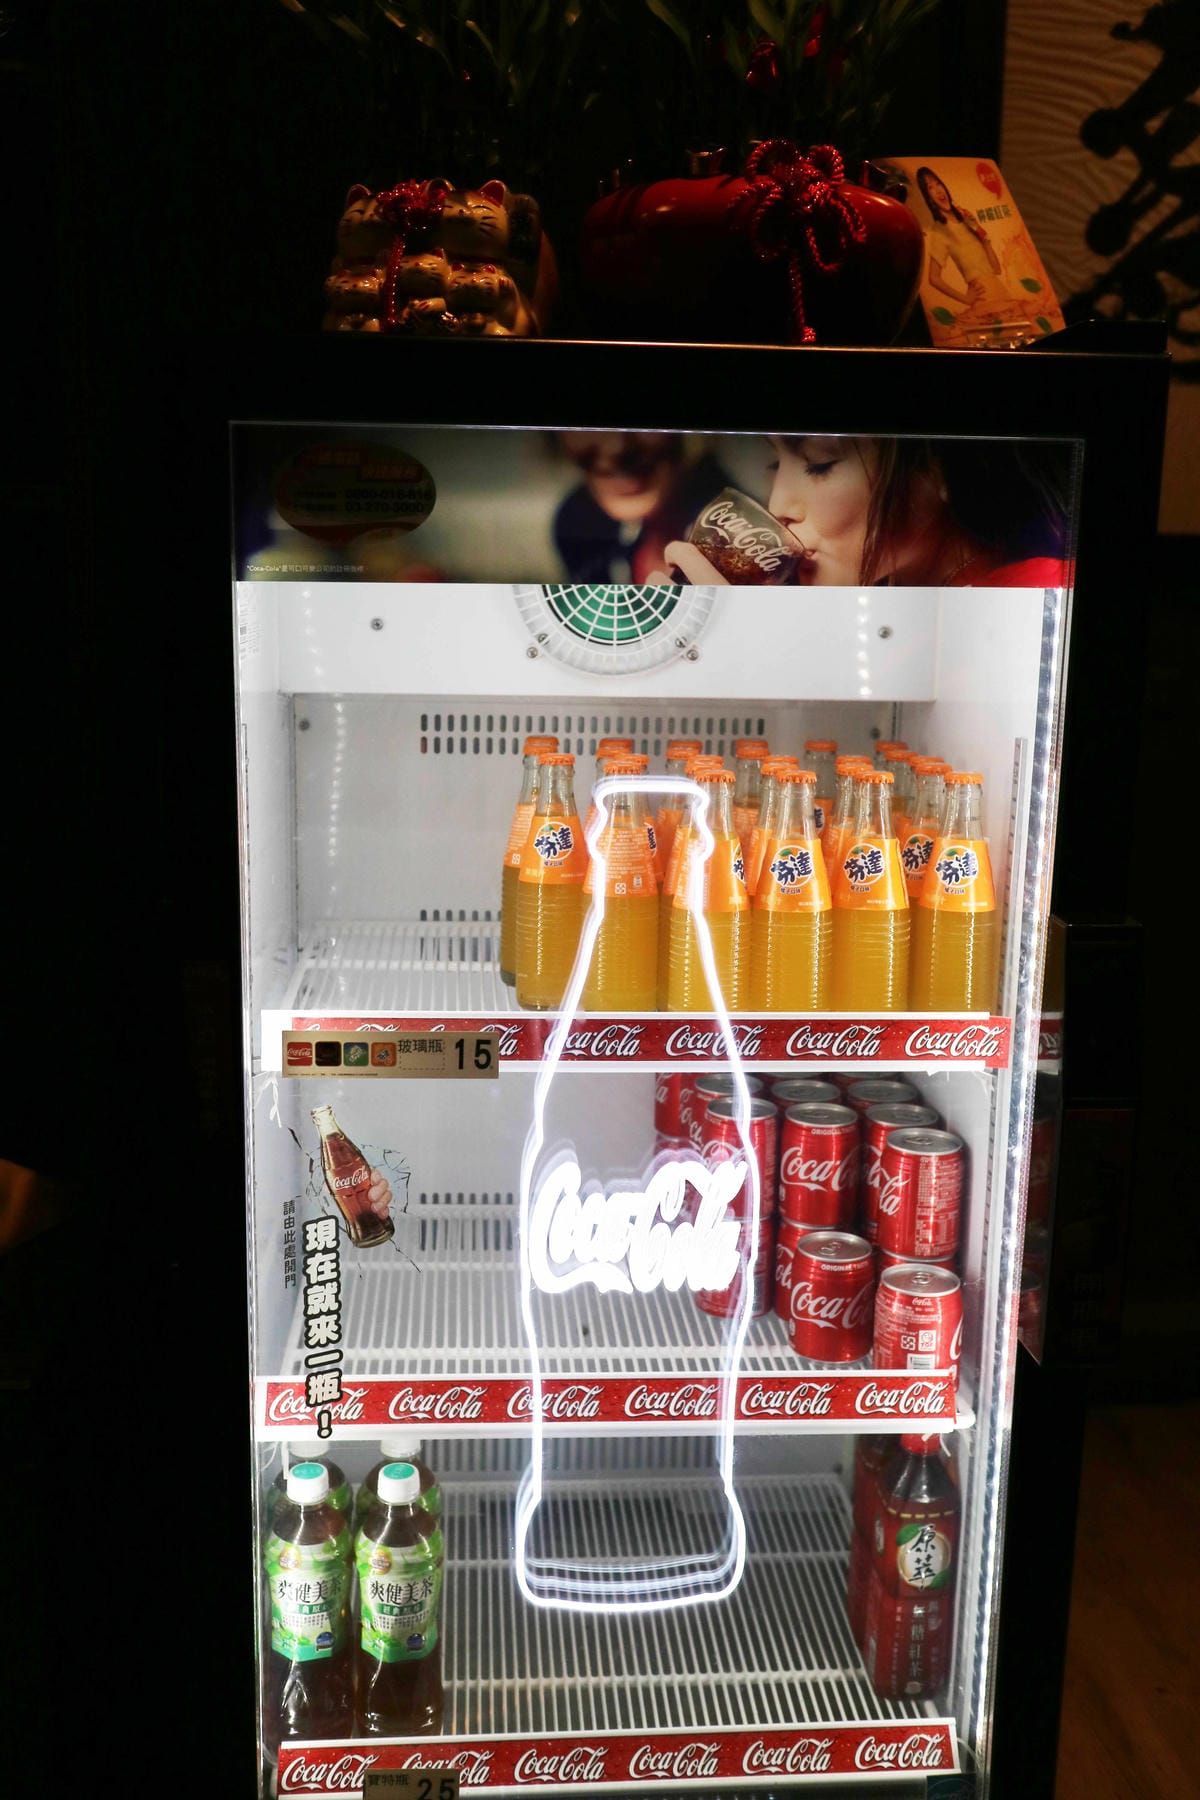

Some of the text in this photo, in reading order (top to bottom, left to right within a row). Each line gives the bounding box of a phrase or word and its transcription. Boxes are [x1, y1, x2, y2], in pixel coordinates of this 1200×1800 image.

[700, 501, 792, 572] Coca-Cola
[534, 826, 573, 859] 芬達
[770, 850, 813, 886] 芬達
[843, 849, 885, 883] 芬達
[935, 851, 978, 885] 芬達
[397, 1039, 443, 1053] 玻璃瓶
[455, 1038, 491, 1069] 15
[543, 1024, 648, 1057] Cca-Cola
[785, 1024, 889, 1057] Coca-Cola
[905, 1024, 1007, 1057] Coca-Cola
[333, 1165, 370, 1191] Coca-Cola
[283, 1199, 297, 1289] 請由此處開門
[388, 1386, 488, 1420] Coca-Cola
[624, 1383, 720, 1418] Coca-Cola
[740, 1382, 836, 1417] Coca-Cola
[854, 1381, 950, 1416] Coca-Cola
[908, 1524, 937, 1592] 原萃
[370, 1576, 433, 1605] 爽健美茶
[514, 1746, 610, 1783] Coca-Cola
[628, 1742, 723, 1778] Coca-Cola
[742, 1737, 835, 1775] Coca-Cola
[853, 1733, 947, 1771] Coca-Cola
[417, 1778, 456, 1800] 25
